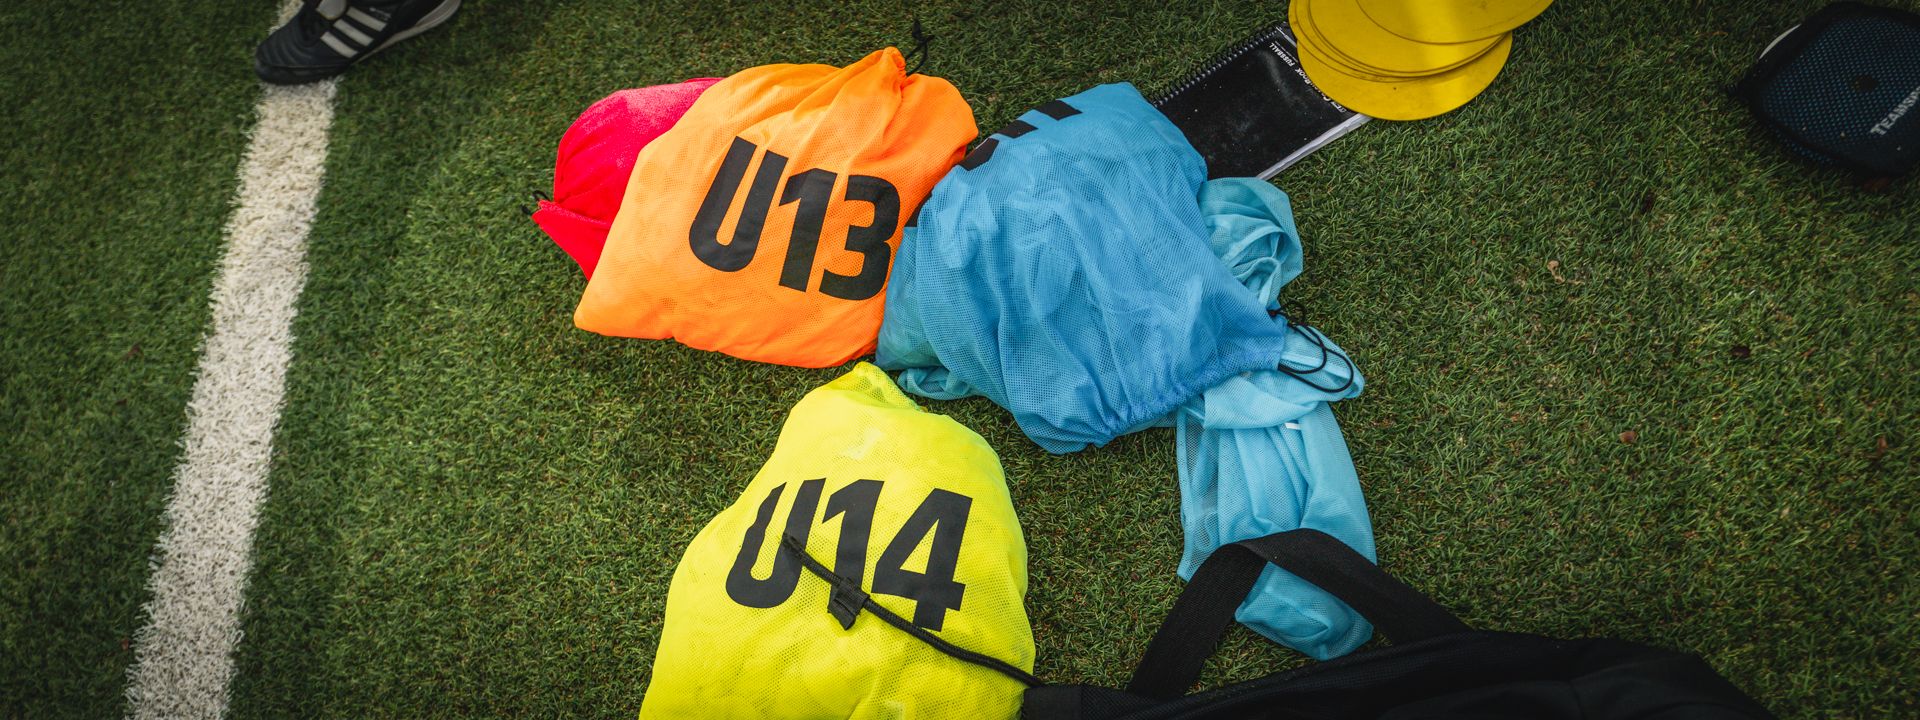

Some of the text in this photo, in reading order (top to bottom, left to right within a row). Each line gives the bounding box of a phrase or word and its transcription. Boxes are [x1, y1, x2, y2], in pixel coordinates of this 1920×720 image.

[1269, 42, 1296, 67] FUSSBALL
[689, 136, 900, 300] U13
[725, 477, 973, 632] U14
